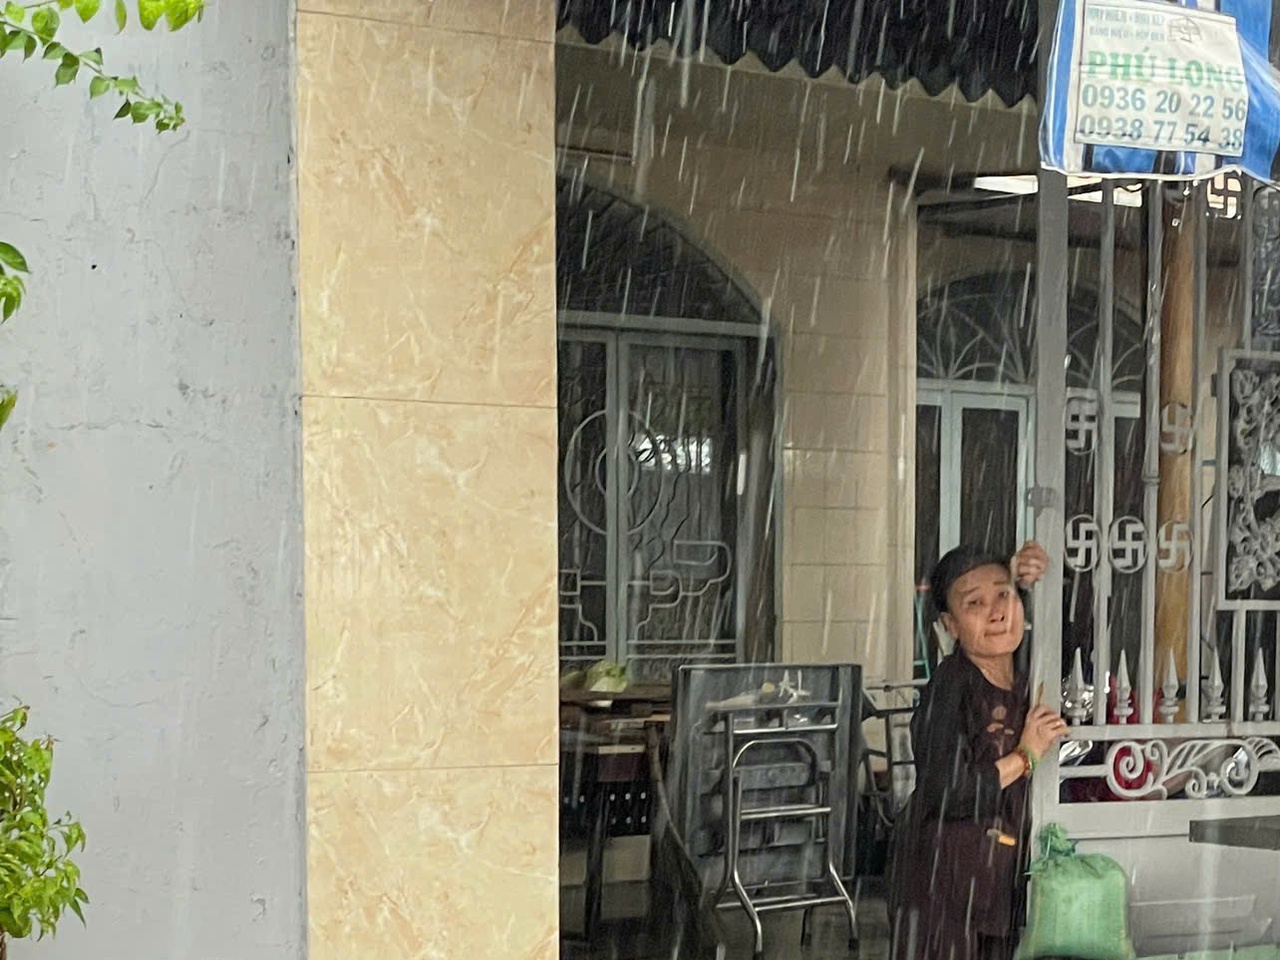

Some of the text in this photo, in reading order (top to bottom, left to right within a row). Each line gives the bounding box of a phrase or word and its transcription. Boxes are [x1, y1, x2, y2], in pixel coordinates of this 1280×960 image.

[1087, 45, 1245, 92] PHÚ LONG
[1081, 83, 1247, 122] 0936 20 22 56
[1079, 114, 1243, 151] 0938 77 54 38
